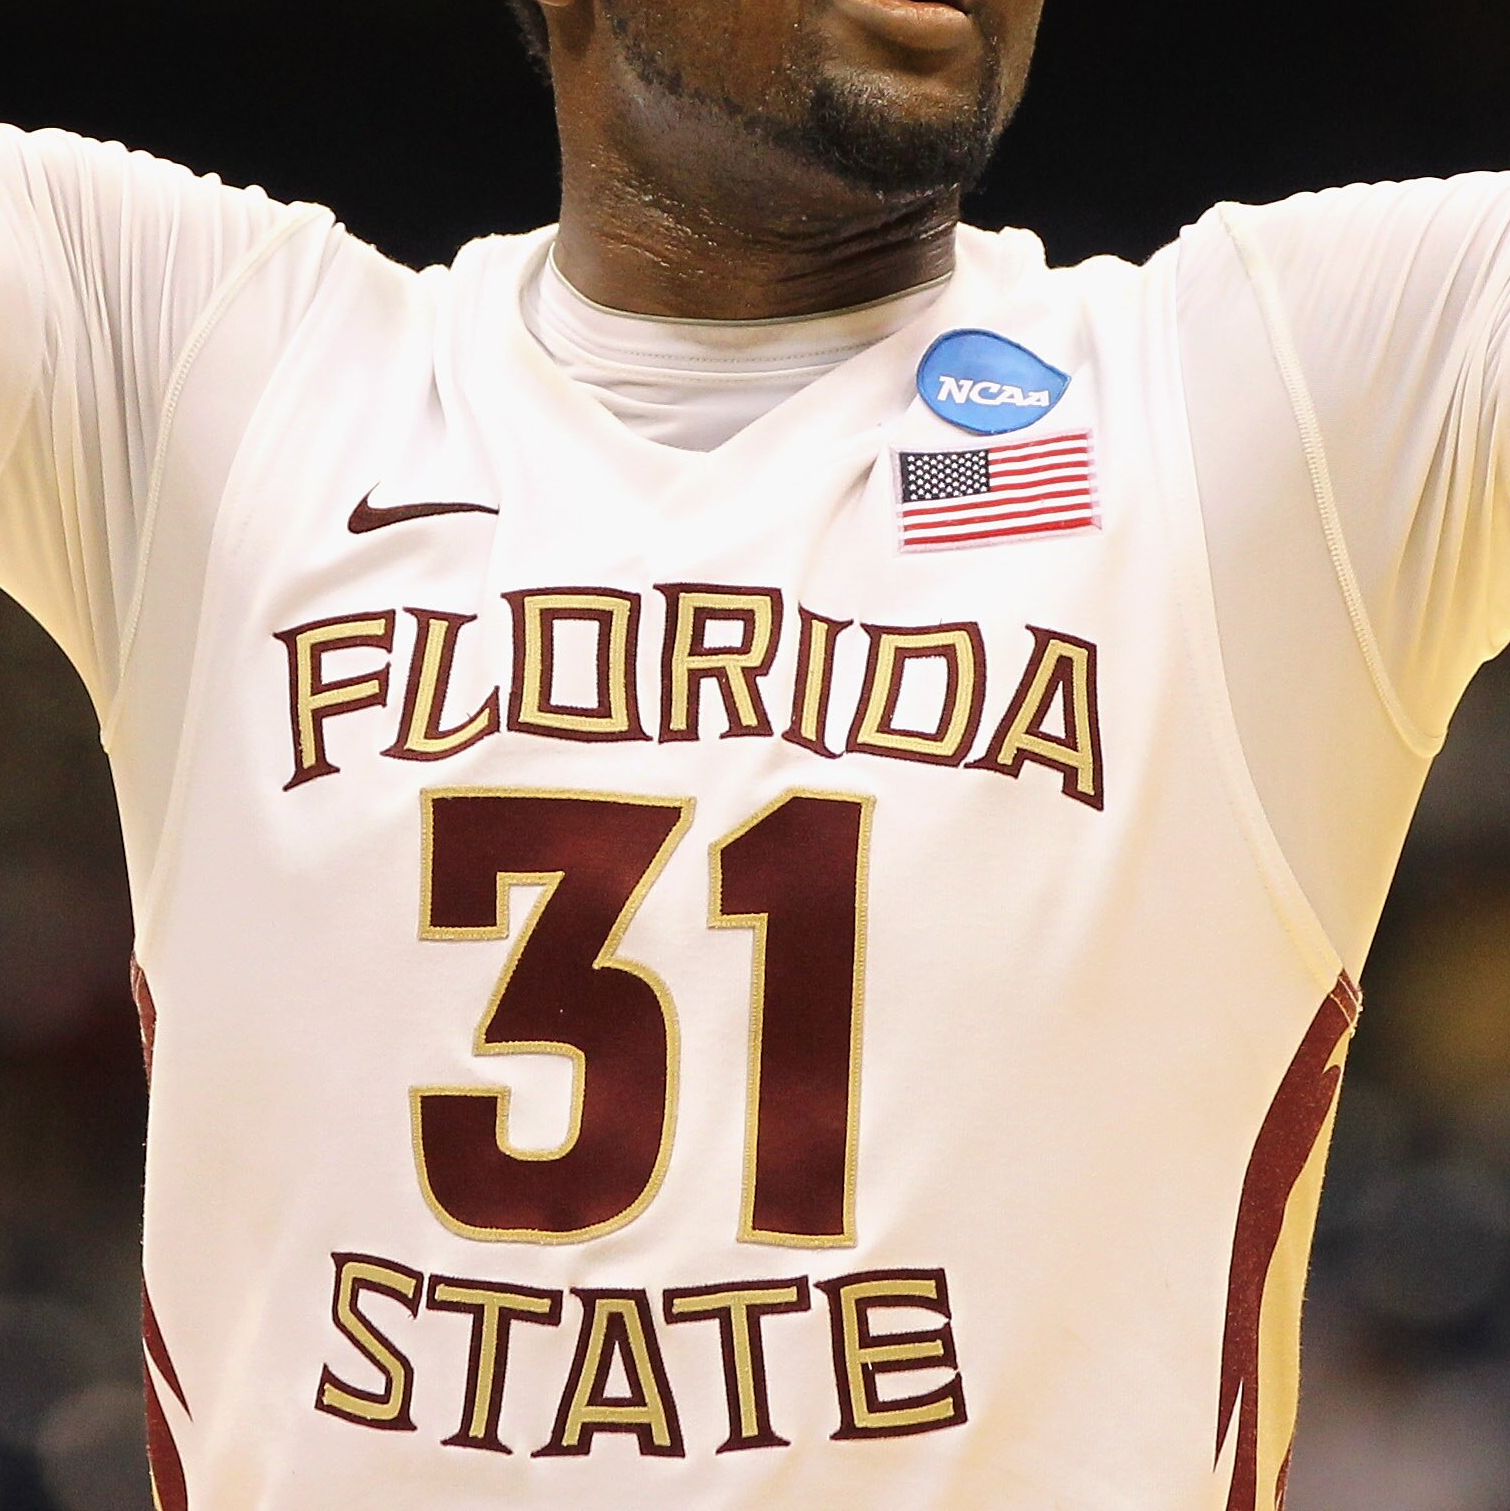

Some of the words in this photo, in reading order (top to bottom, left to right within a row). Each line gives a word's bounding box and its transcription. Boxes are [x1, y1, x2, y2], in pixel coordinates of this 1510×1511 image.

[937, 375, 1050, 407] NCAA
[273, 582, 1103, 810] FLORIDA
[409, 787, 876, 1247] 31
[315, 1252, 968, 1457] STATE
